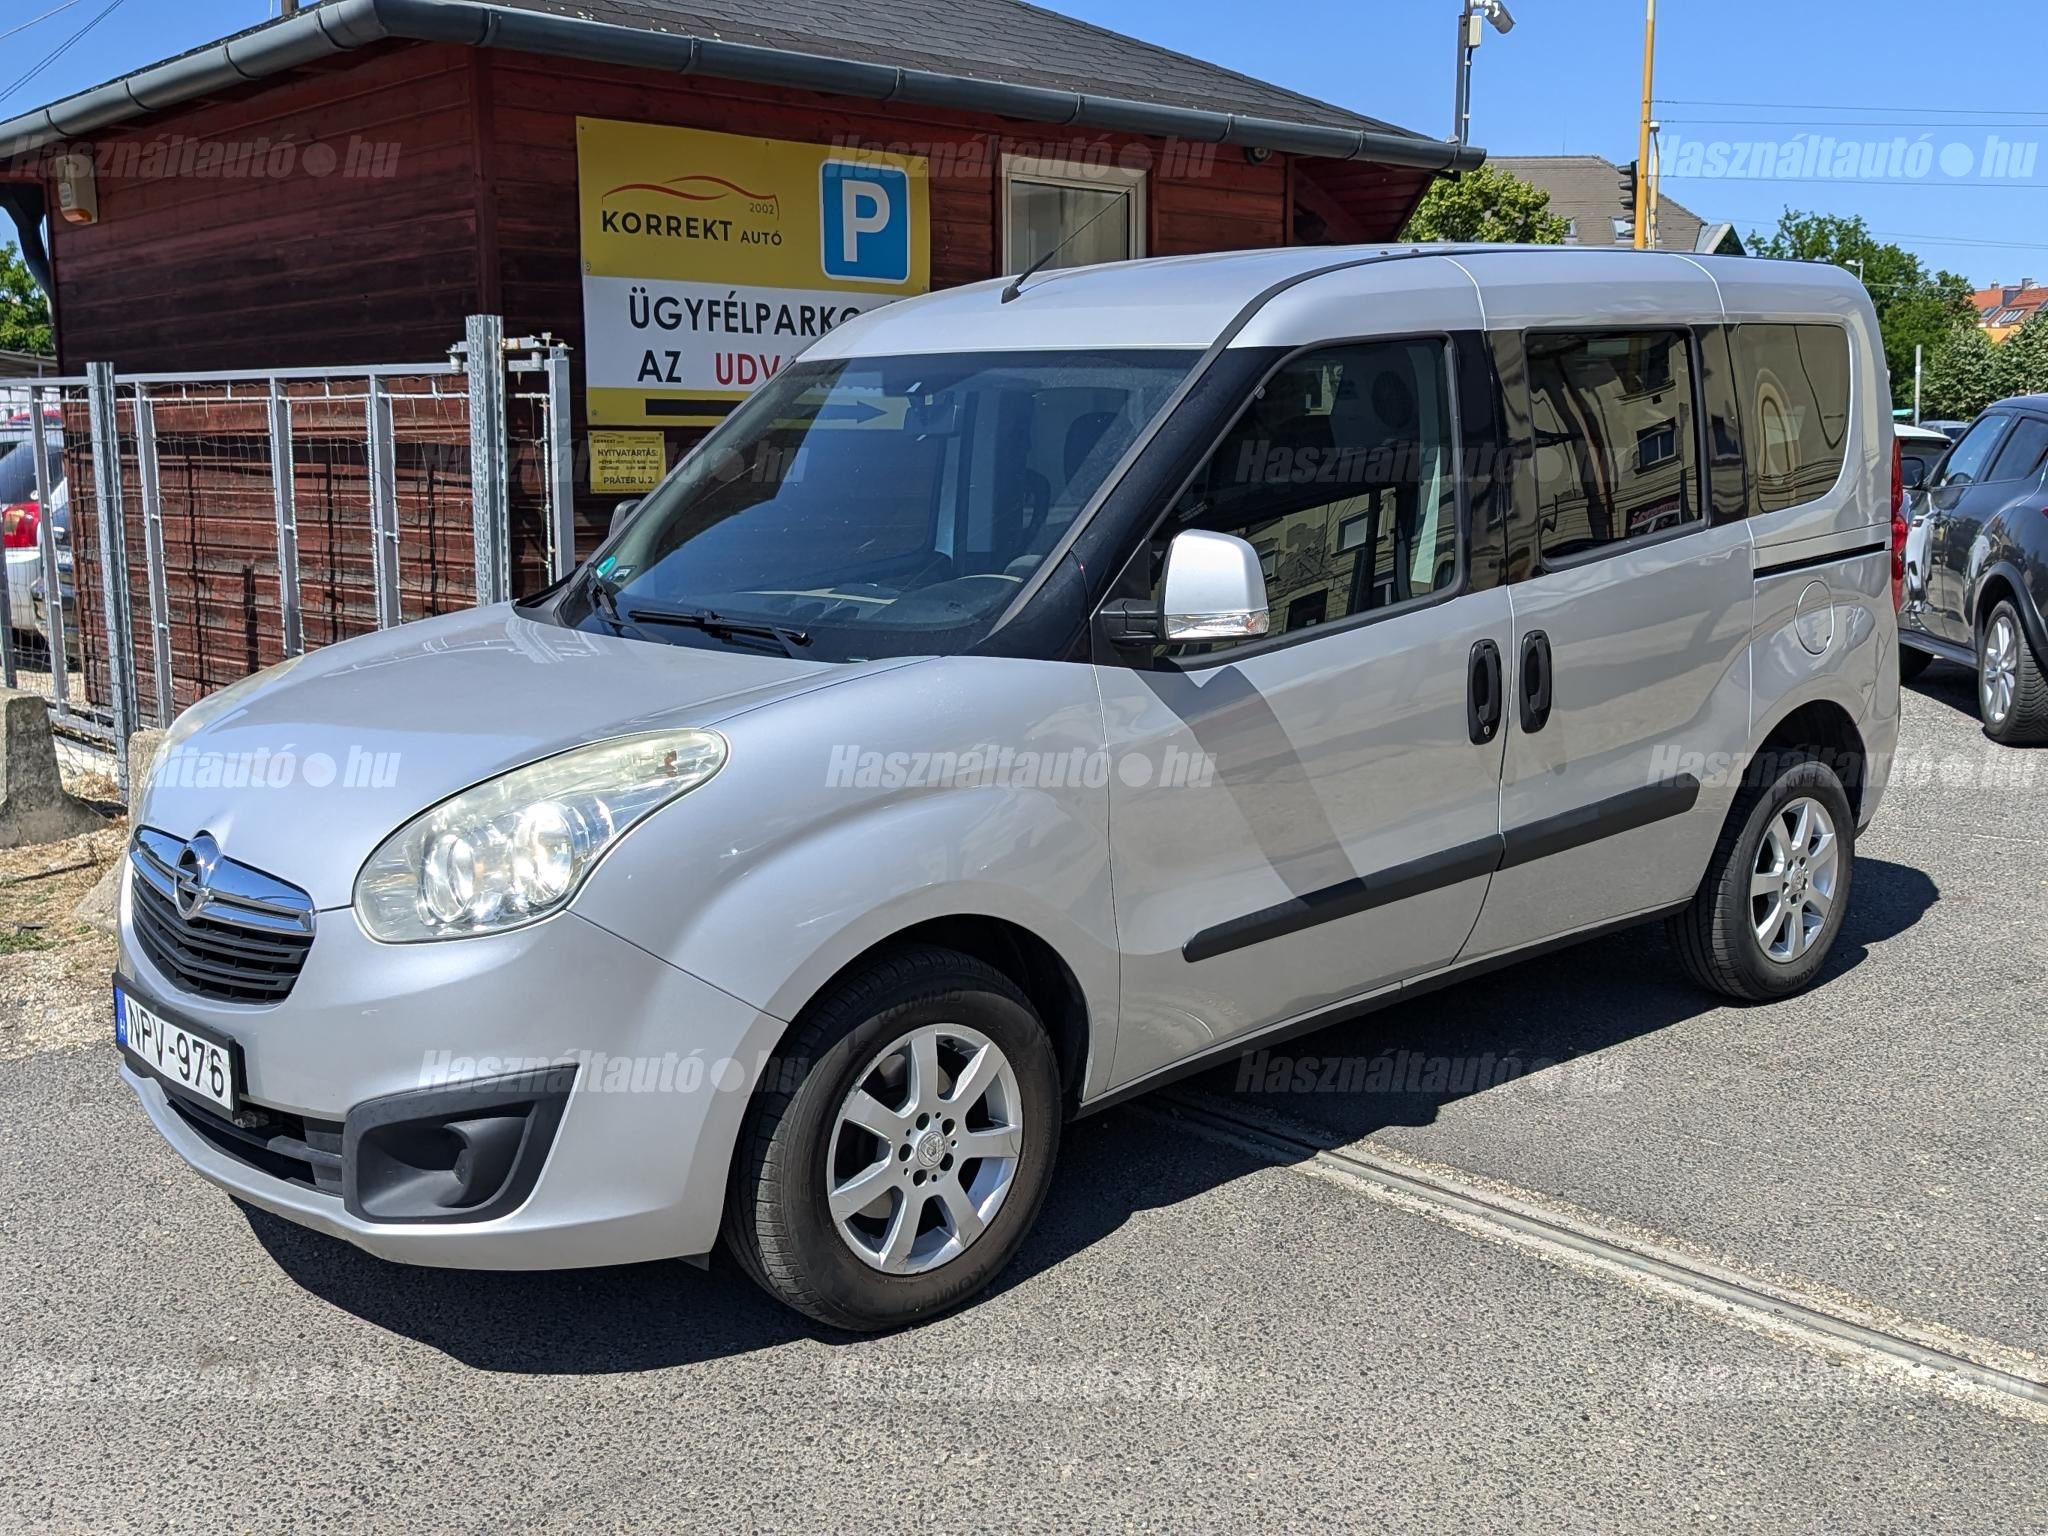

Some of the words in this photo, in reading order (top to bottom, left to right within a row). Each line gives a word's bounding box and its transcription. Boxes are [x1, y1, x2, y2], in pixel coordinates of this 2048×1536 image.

[749, 203, 775, 215] 2002
[842, 179, 890, 262] P
[602, 210, 732, 242] KORREKT
[740, 230, 782, 246] AUTÓ
[637, 350, 682, 384] AZ
[119, 1018, 126, 1036] H
[127, 999, 225, 1098] NPV-976
